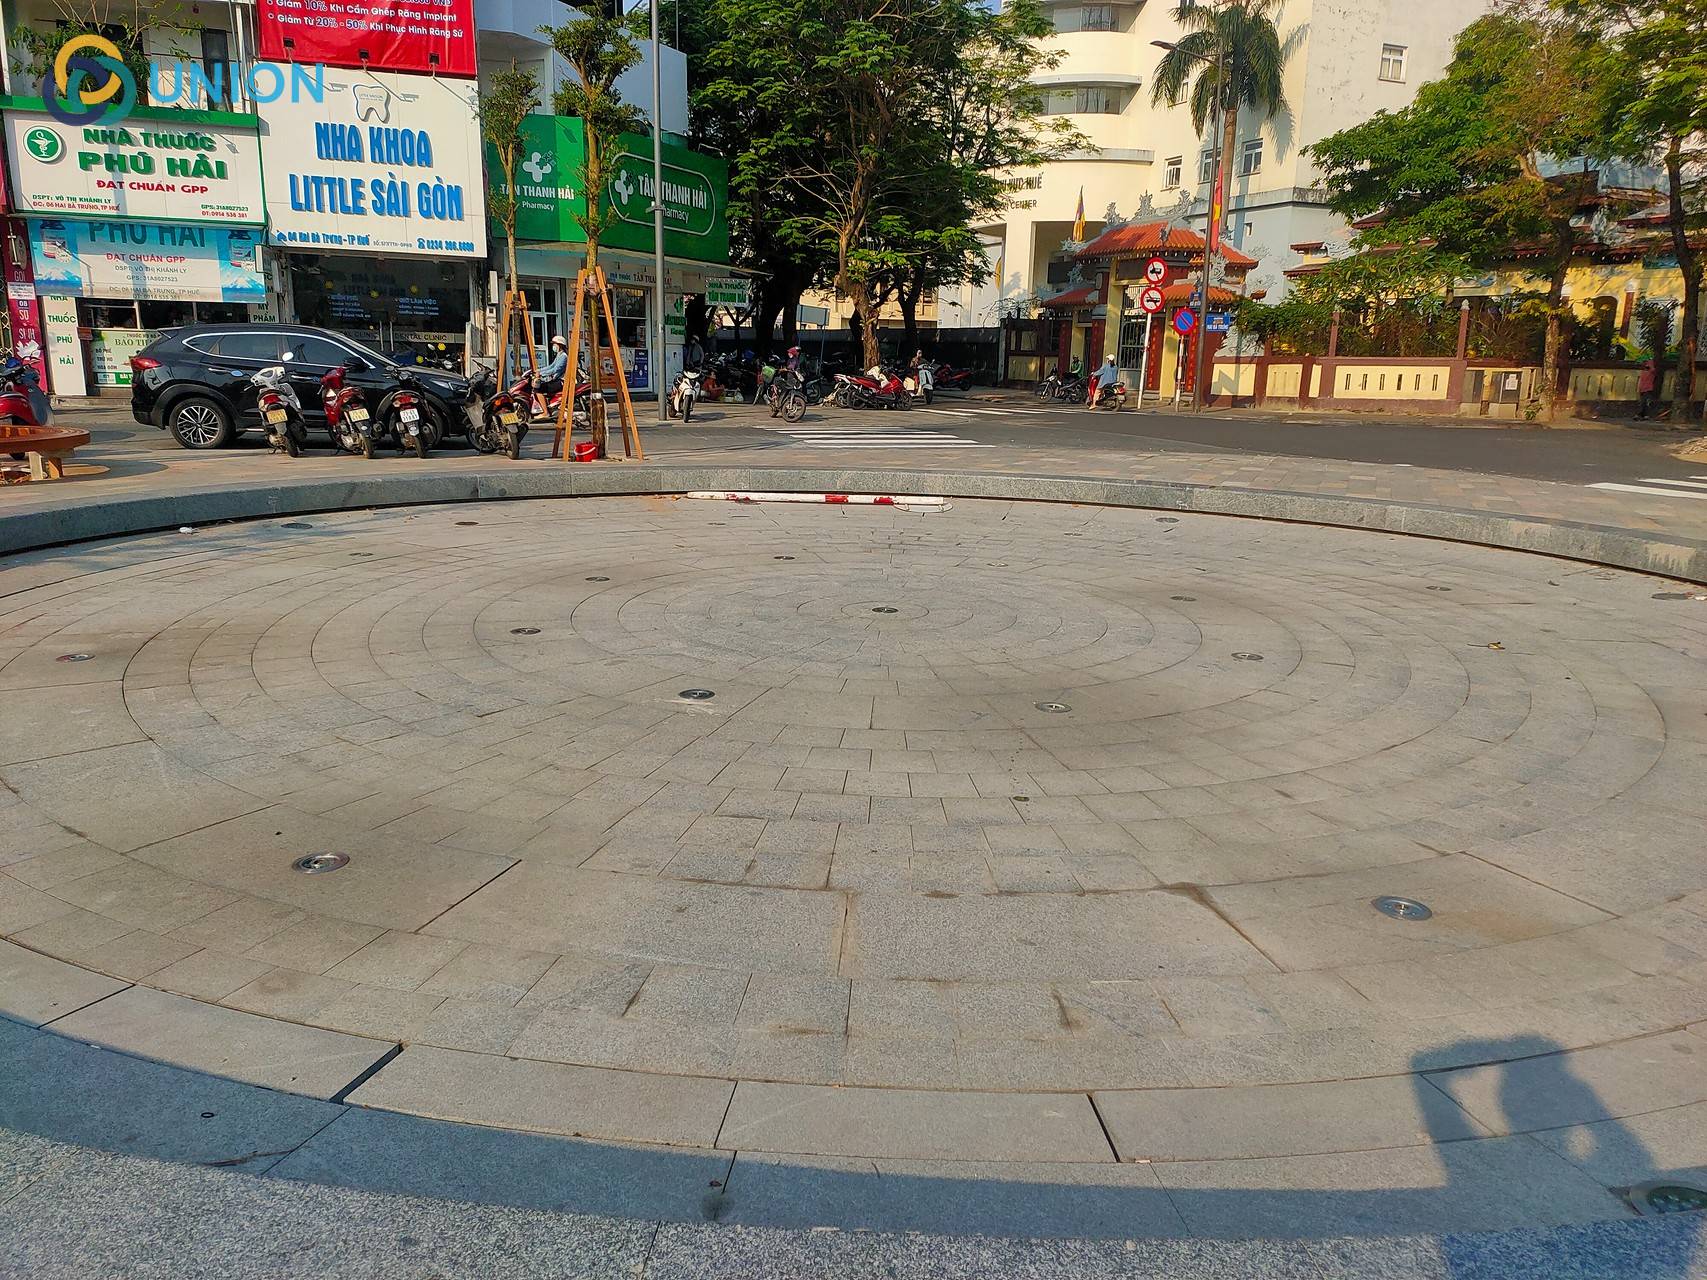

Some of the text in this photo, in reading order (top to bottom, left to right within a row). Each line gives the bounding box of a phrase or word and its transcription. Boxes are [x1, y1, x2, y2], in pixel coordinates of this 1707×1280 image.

[330, 3, 344, 12] Khi
[424, 11, 457, 22] Implant
[277, 14, 302, 24] Giảm
[316, 16, 338, 28] 20%
[347, 19, 369, 30] 50%
[370, 22, 383, 31] Khi
[83, 127, 217, 151] NHÀ THUỐC
[315, 122, 433, 167] NHA KHOA
[166, 153, 228, 179] HẢI
[181, 185, 209, 194] GPP
[288, 172, 464, 221] LITTLE SÀI GÒN
[523, 185, 556, 199] THANH
[558, 184, 576, 200] HẢI
[661, 181, 691, 206] THANH
[692, 184, 707, 210] HẢI
[522, 200, 555, 211] Pharmacy
[167, 256, 186, 264] GPP
[48, 311, 76, 323] THUỐC
[60, 354, 75, 365] HẢI
